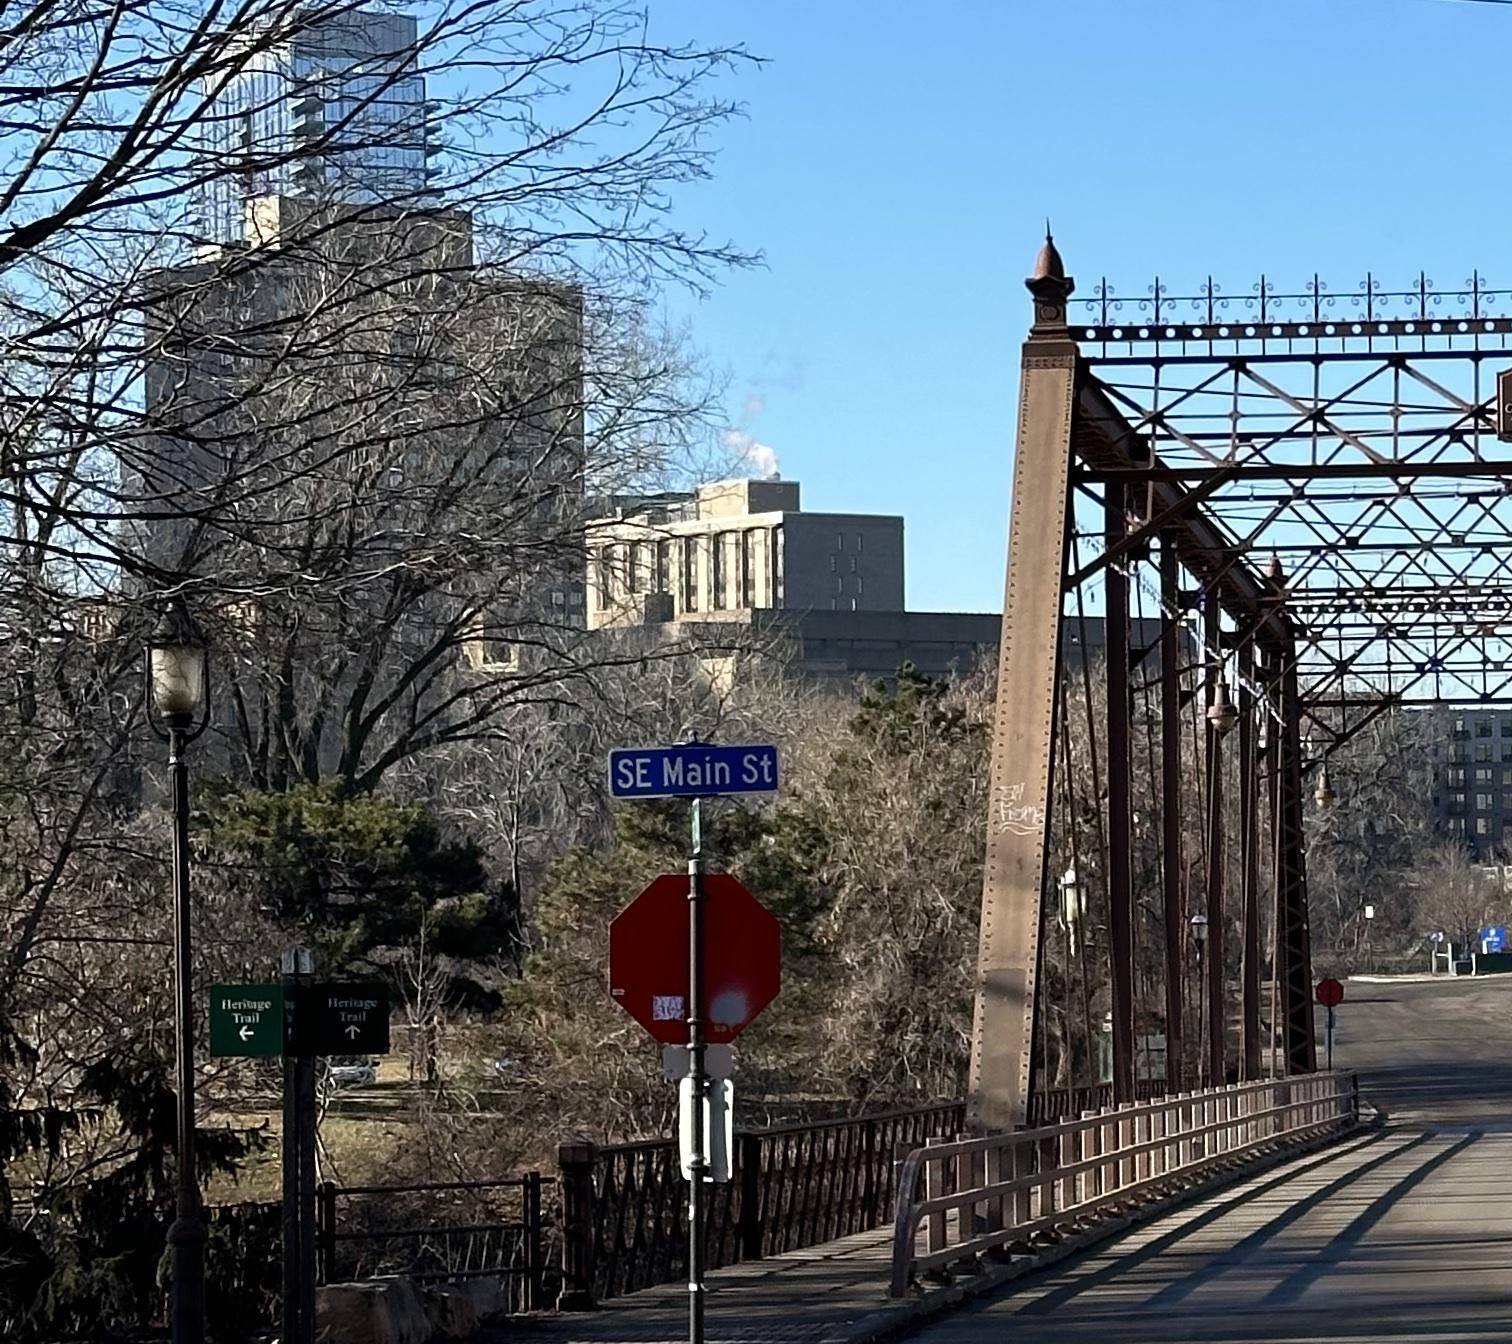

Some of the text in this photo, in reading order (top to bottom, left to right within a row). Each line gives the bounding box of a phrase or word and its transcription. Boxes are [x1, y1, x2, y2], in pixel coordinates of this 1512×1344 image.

[617, 753, 773, 789] SE Main St
[221, 998, 272, 1011] Heritage
[328, 997, 378, 1009] Heritage
[232, 1012, 260, 1024] Trail
[340, 1010, 367, 1022] Trail
